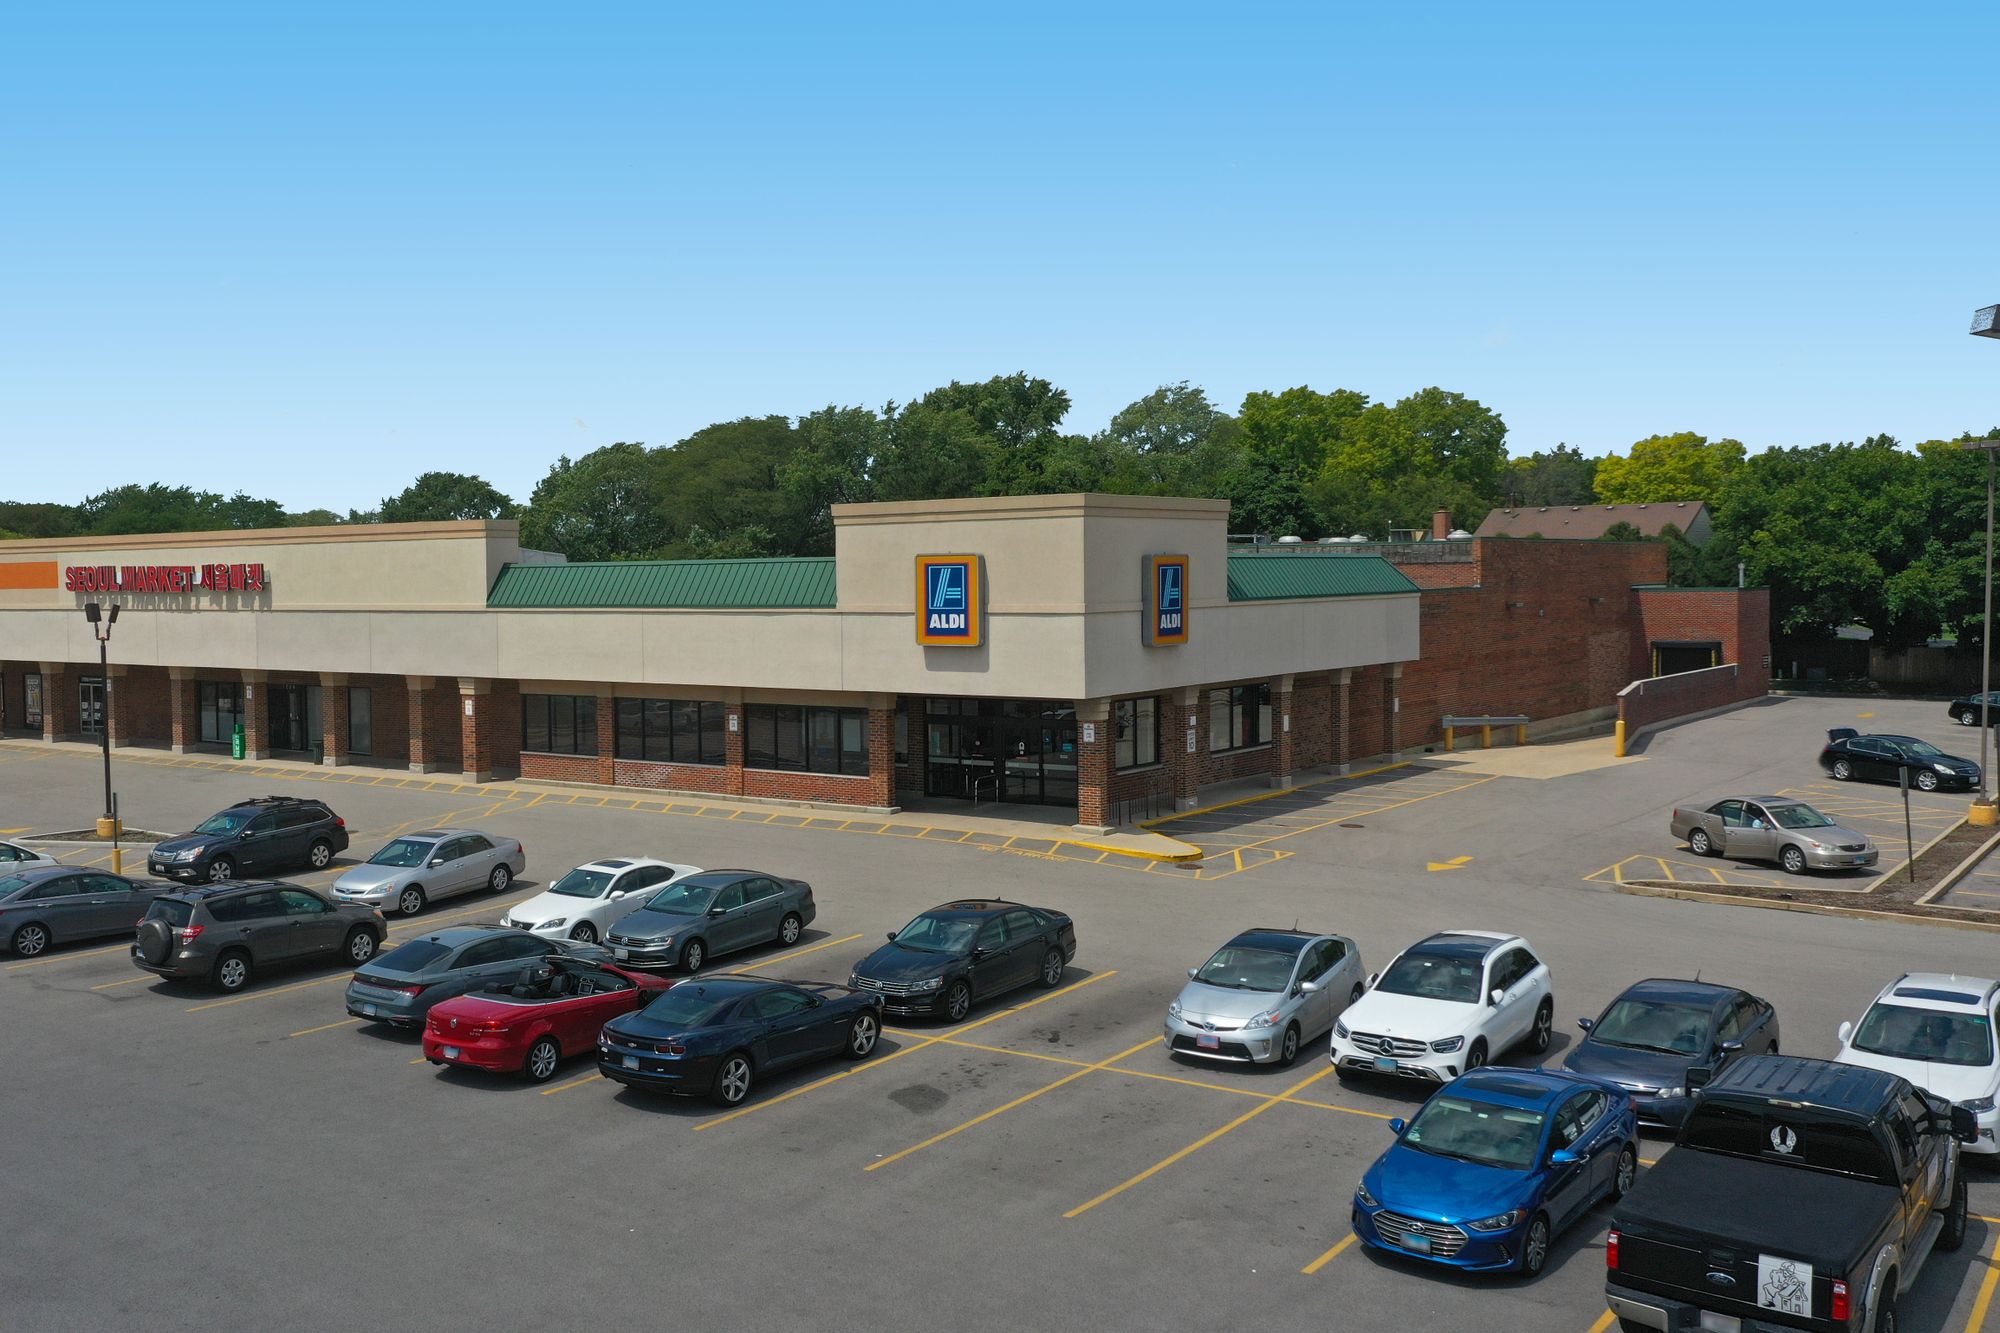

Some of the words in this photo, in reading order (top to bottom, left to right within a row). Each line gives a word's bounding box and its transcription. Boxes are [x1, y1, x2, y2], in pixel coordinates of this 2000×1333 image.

[65, 566, 119, 592] SEOUL
[120, 565, 193, 592] MARKET
[200, 563, 264, 591] 서울마켓
[929, 613, 965, 628] ALDI
[1160, 613, 1181, 628] ALDI
